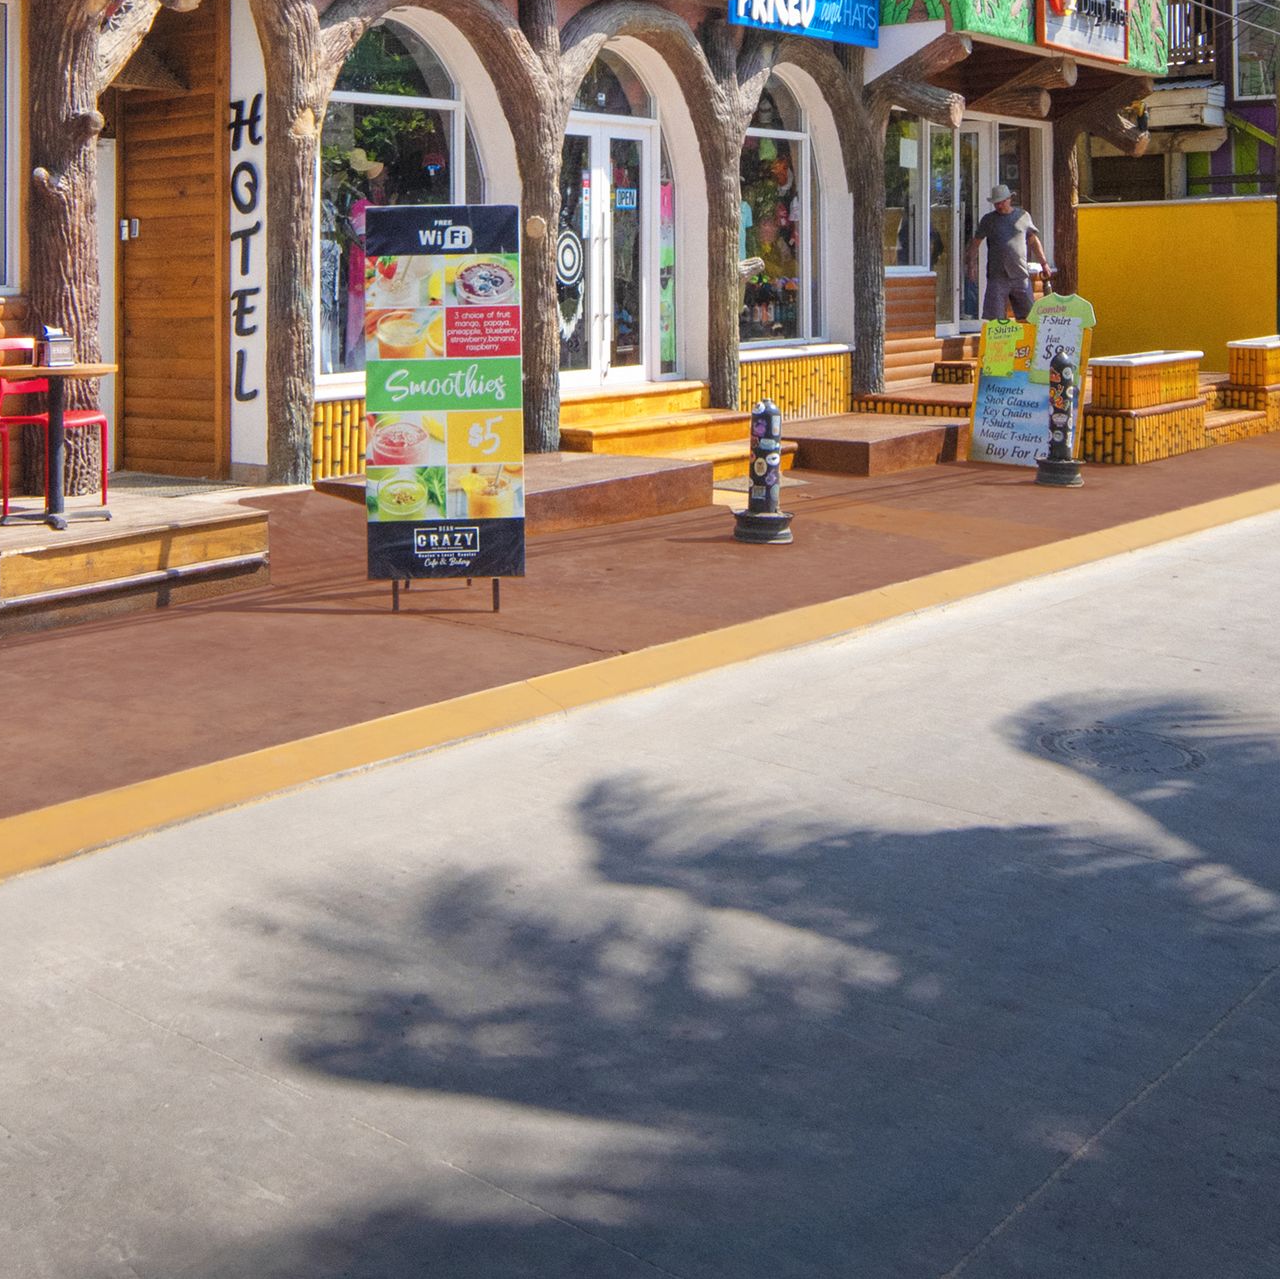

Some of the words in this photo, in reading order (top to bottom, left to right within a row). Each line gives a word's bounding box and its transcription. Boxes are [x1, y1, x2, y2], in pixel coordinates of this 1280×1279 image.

[617, 191, 635, 207] OPEN
[418, 229, 468, 247] WiFi
[228, 93, 263, 402] HOTEL
[1042, 315, 1072, 326] T-Shirt
[987, 325, 1018, 336] T-Shirts
[1045, 334, 1061, 343] Hat
[385, 363, 506, 402] Smoothies
[985, 384, 1024, 396] Magnets
[984, 395, 1005, 405] Shot
[1006, 398, 1040, 409] Glasses
[982, 406, 1002, 417] Key
[1002, 408, 1032, 419] Chains
[982, 417, 1015, 429] T-Shirts
[468, 415, 504, 455] $5
[980, 428, 1008, 441] Magic
[985, 443, 1009, 459] Buy
[1011, 446, 1031, 459] For
[417, 533, 474, 547] CRAZY
